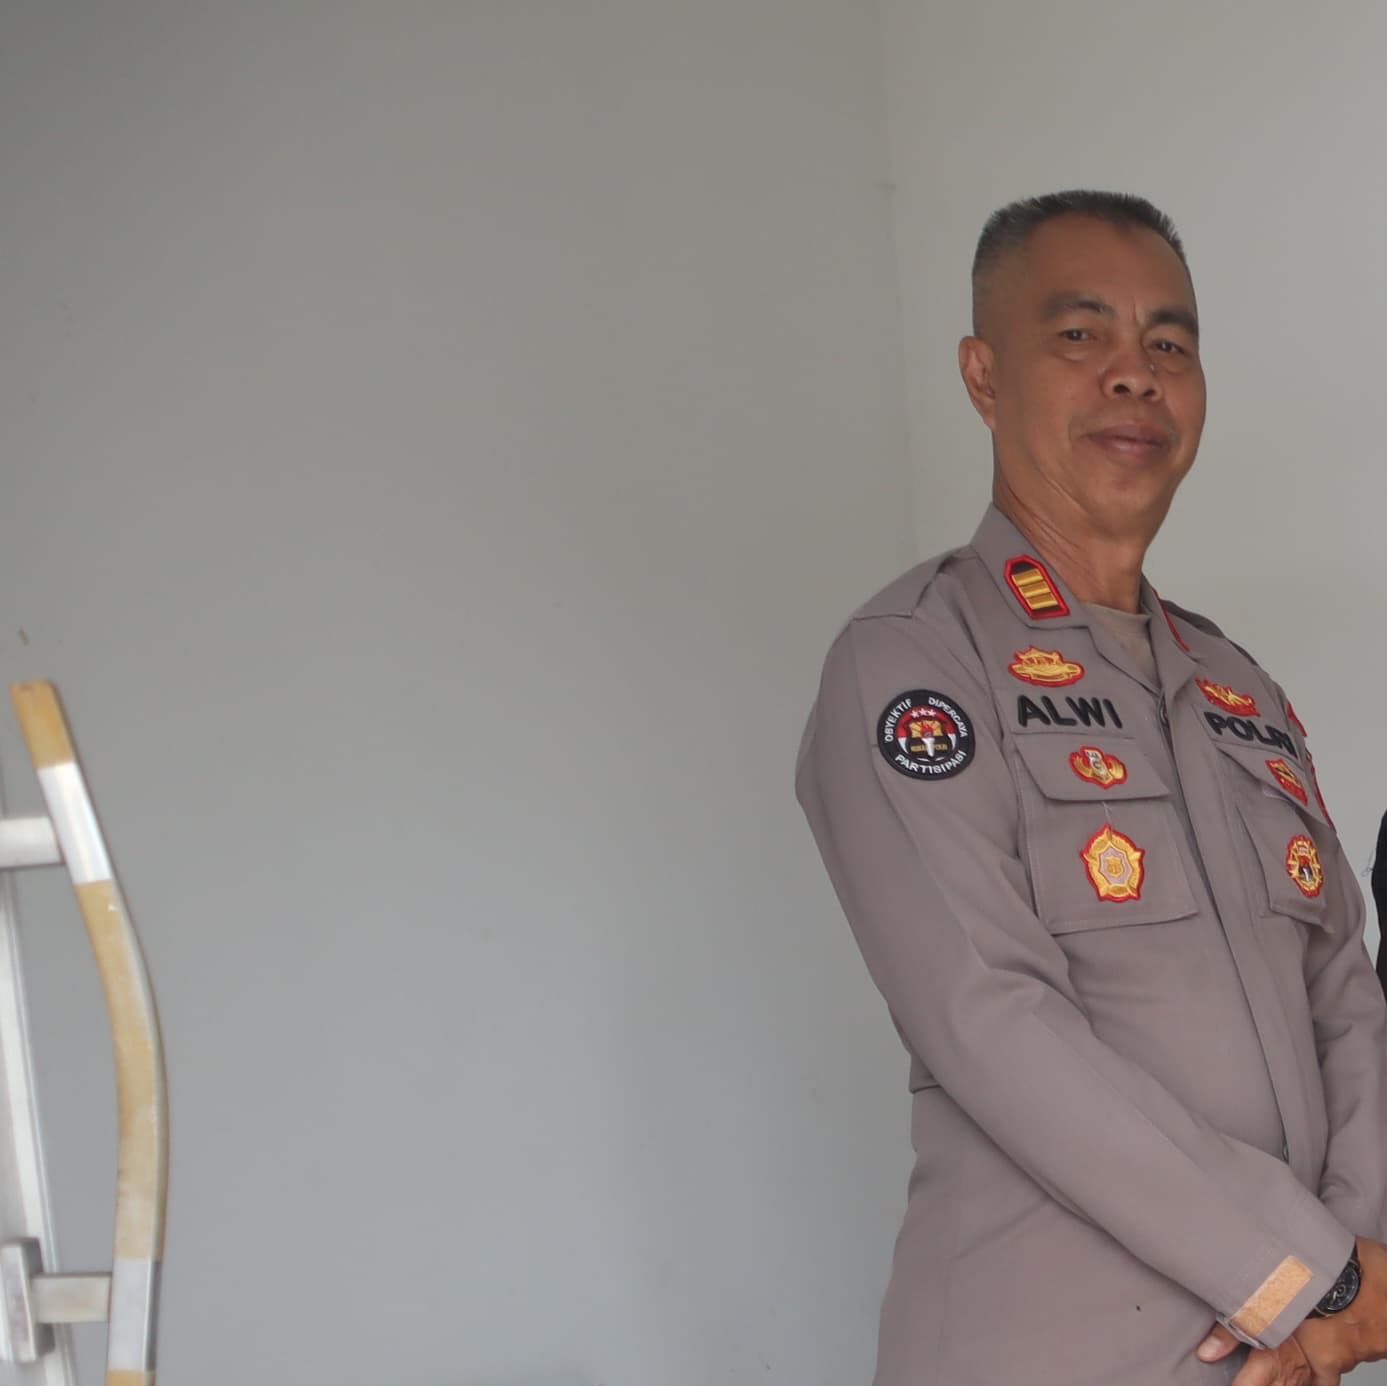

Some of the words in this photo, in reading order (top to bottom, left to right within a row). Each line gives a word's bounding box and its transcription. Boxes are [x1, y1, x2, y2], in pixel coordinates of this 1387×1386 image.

[884, 698, 912, 743] OBYEKTIF
[928, 696, 968, 738] DIPERCAYA
[1018, 694, 1124, 730] ALWI
[1203, 711, 1299, 760] POLRI
[895, 750, 967, 774] PARTISIPASI
